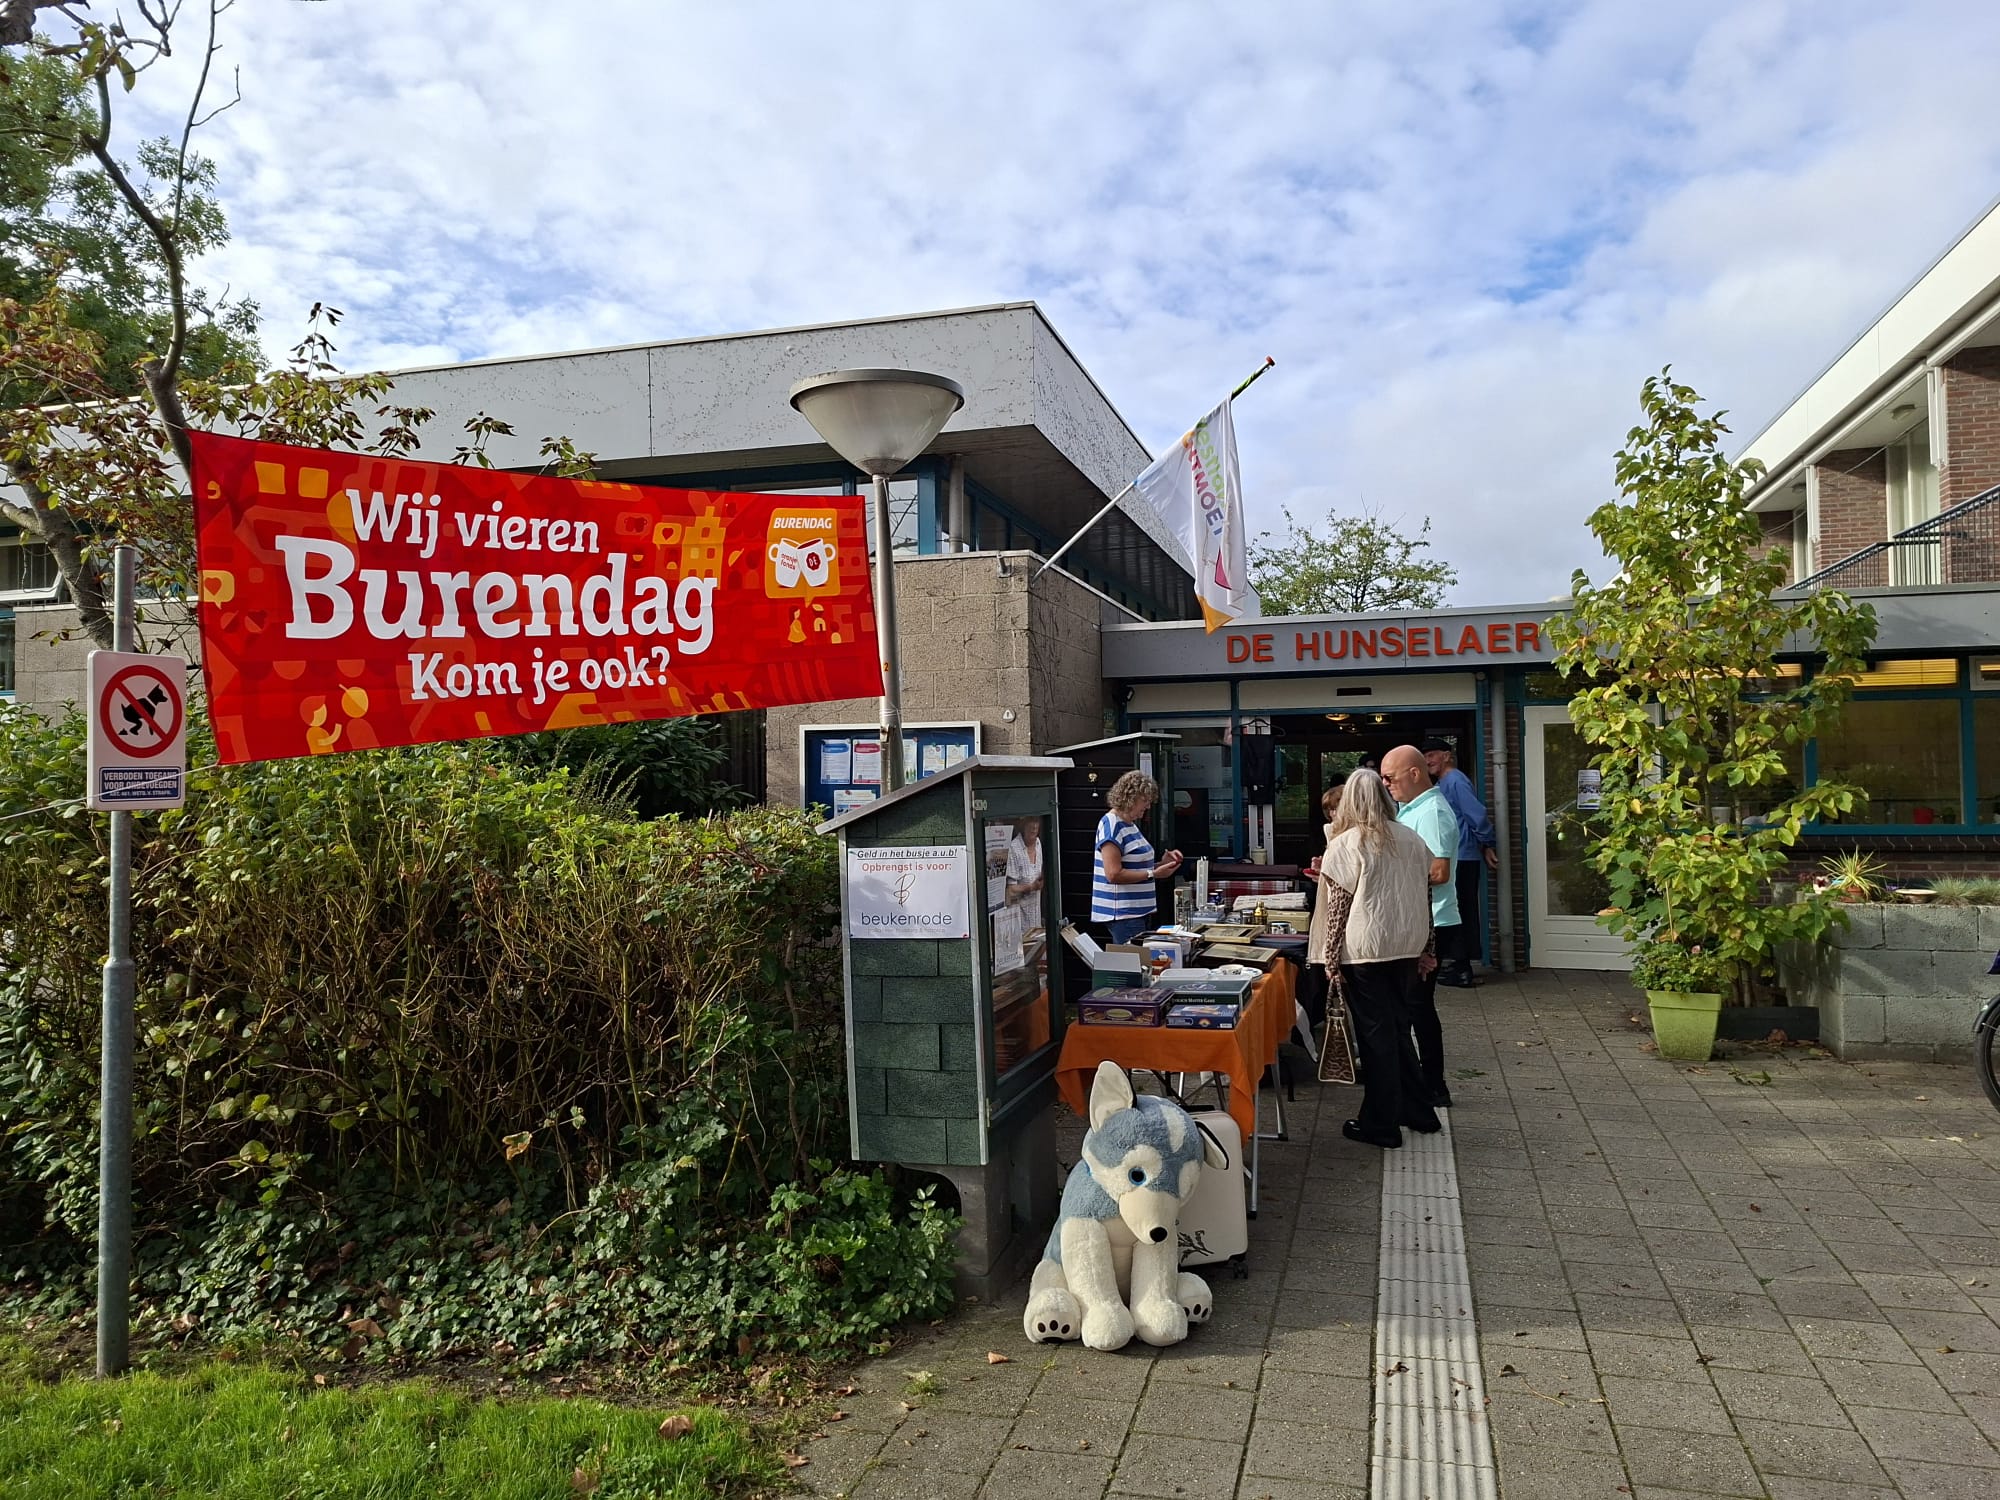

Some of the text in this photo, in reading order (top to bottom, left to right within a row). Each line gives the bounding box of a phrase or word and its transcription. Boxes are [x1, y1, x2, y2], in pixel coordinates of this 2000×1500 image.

[345, 488, 600, 559] Wij vieren
[773, 517, 833, 529] BURENDAG
[808, 556, 819, 567] DE
[275, 534, 718, 655] Burendag
[1226, 622, 1541, 663] DE HUNSELAER
[407, 645, 670, 705] Kom je ook?
[103, 771, 177, 781] VERBODEN TOEGANG
[103, 782, 125, 790] VOOR
[857, 848, 958, 859] Geld in het busje a.u.b!
[861, 862, 952, 874] Opbrengst is voor:
[861, 911, 953, 926] beukenrode
